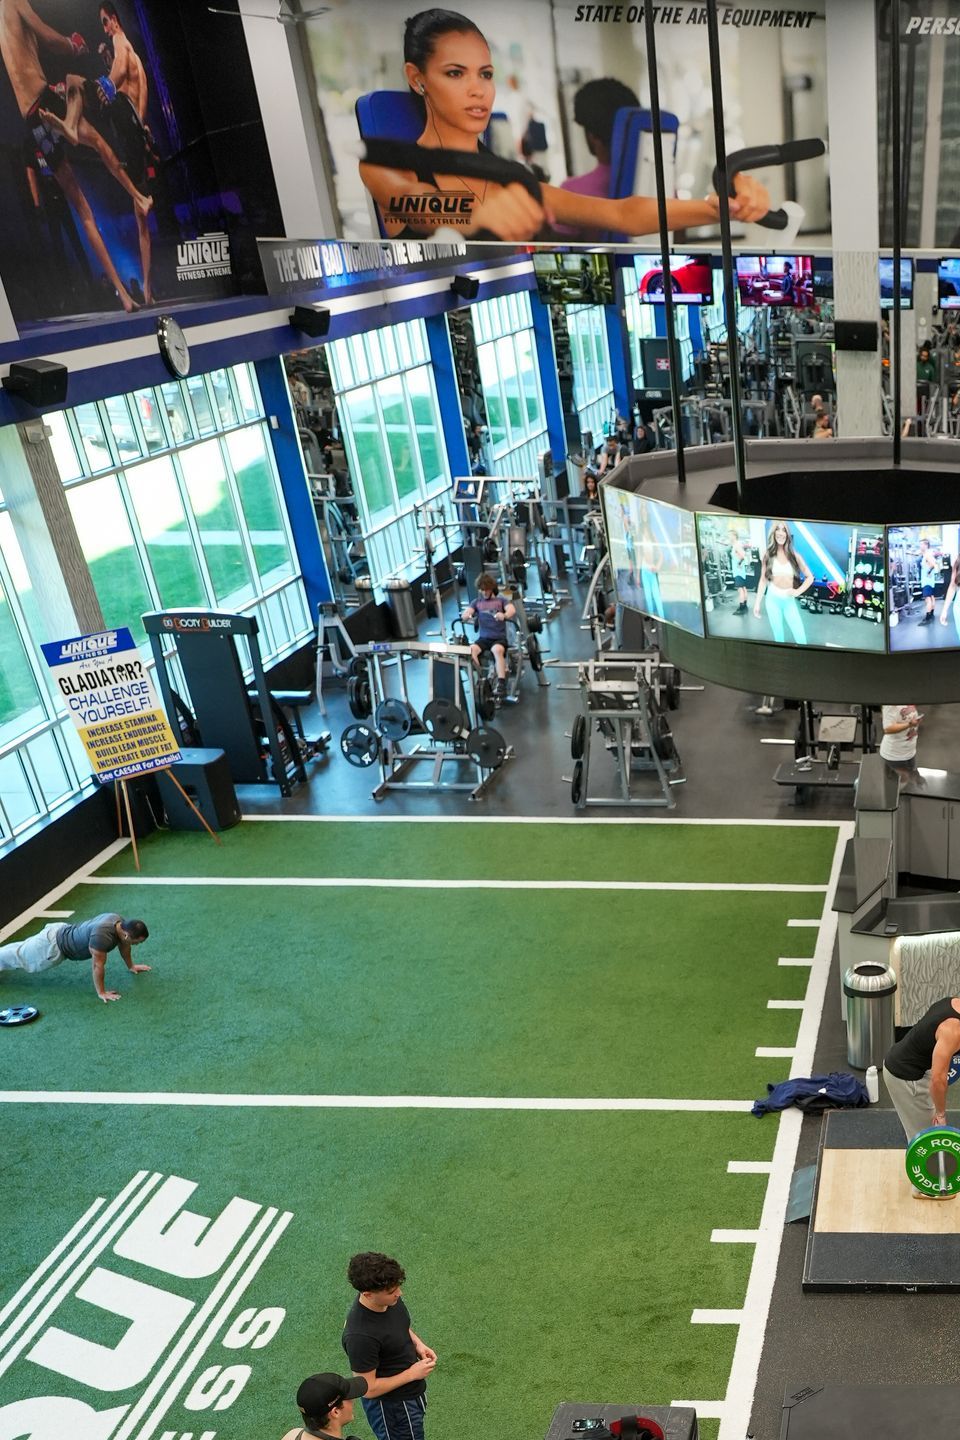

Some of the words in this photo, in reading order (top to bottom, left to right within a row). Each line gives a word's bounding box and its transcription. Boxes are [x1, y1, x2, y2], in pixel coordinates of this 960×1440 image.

[574, 5, 623, 23] STATE
[686, 8, 719, 25] AR
[721, 9, 816, 28] EQUIPMENT
[388, 197, 475, 214] UNIQUE
[384, 217, 427, 225] FITNESS
[430, 217, 472, 225] XTREME
[177, 240, 230, 266] UNIQUE
[272, 248, 299, 283] THE
[296, 245, 324, 281] ONLY
[320, 243, 344, 277] BAD
[176, 270, 206, 281] FITNESS
[205, 266, 232, 278] XTREME
[61, 633, 118, 656] UNIQUE
[71, 649, 108, 661] FITNESS
[68, 681, 150, 711] CHALLENGE
[78, 696, 153, 725] YOURSELF!
[86, 722, 124, 738] INCREASE
[123, 713, 158, 729] STAMINA
[86, 733, 124, 750] INCREASE
[123, 722, 167, 740] ENDURANCE
[95, 745, 119, 759] BUILD
[119, 741, 137, 753] LEAN
[137, 733, 167, 747] MUSCLE
[96, 751, 140, 769] INCINERATE
[139, 746, 160, 758] BODY
[160, 742, 173, 752] FAT
[99, 772, 114, 782] See
[113, 764, 142, 777] CAESAR
[141, 760, 154, 770] For
[916, 1146, 929, 1155] 25
